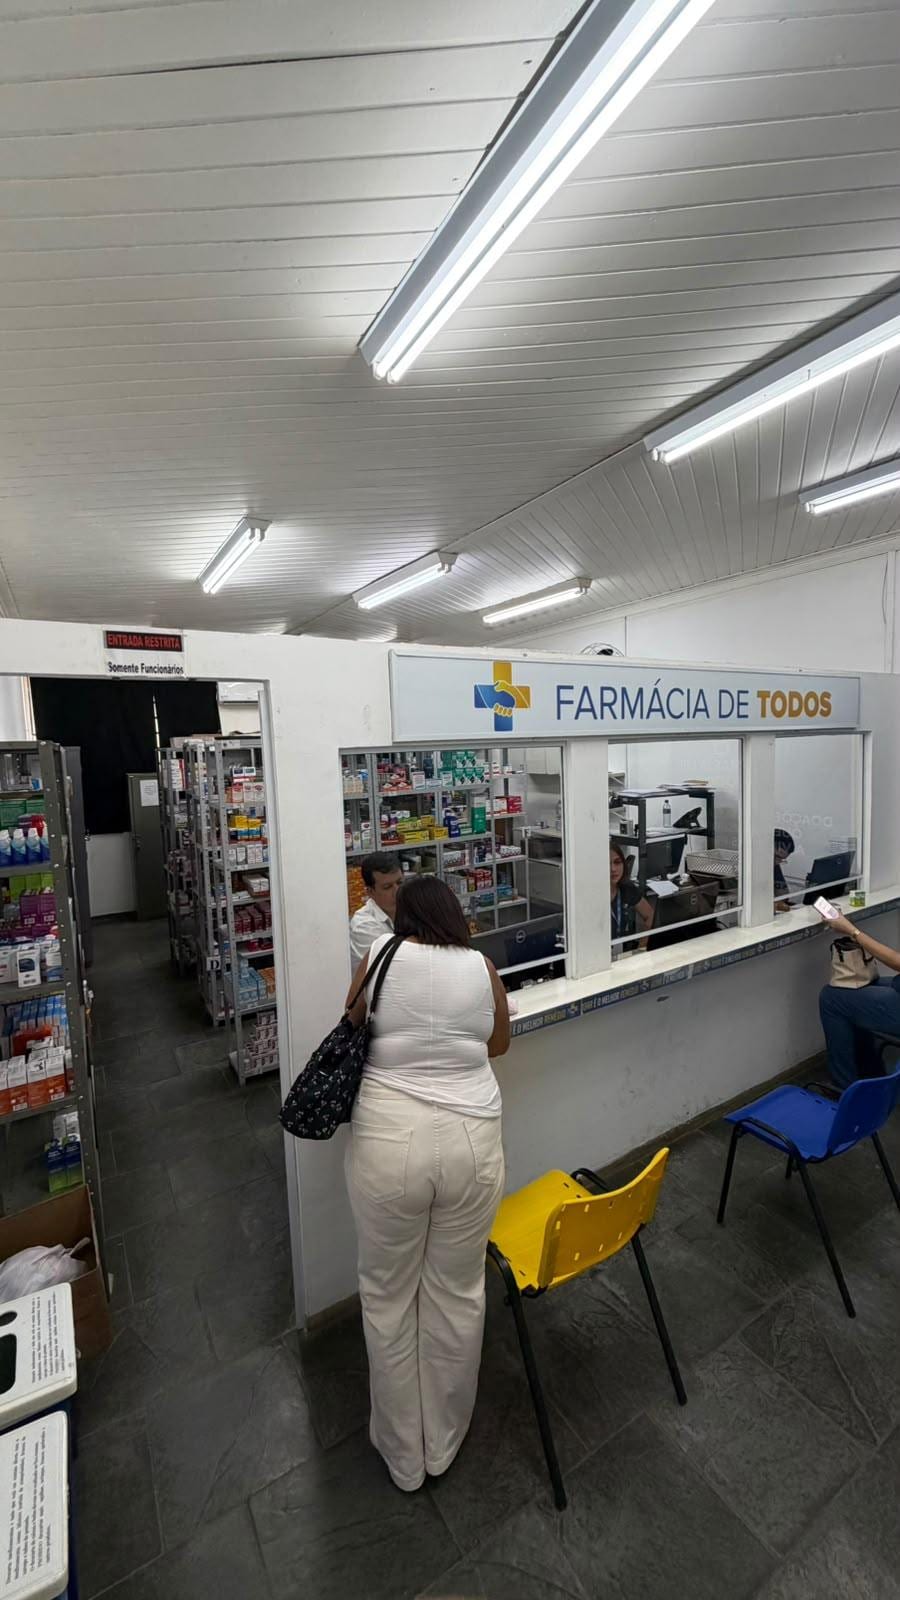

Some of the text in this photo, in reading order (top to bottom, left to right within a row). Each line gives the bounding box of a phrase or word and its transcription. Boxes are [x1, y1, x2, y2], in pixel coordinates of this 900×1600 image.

[108, 634, 181, 649] ENTRADA RESTRITA
[108, 661, 184, 675] Somente Funcionários
[556, 678, 833, 720] FARMÁCIA DE TODOS
